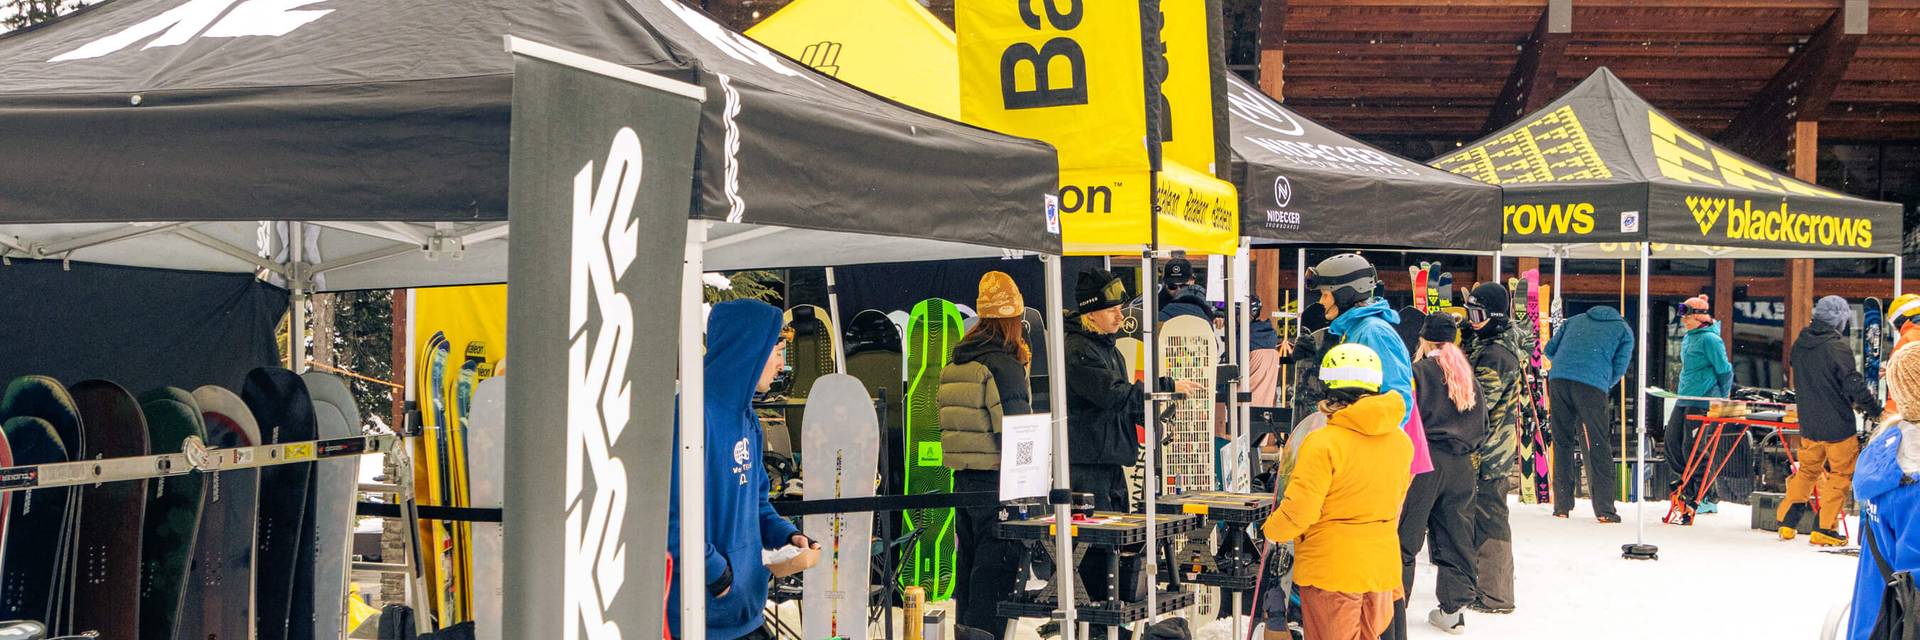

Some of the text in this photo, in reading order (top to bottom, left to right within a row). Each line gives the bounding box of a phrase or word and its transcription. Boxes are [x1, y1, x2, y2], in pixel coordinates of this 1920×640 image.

[1244, 136, 1402, 167] NIDECKER
[1267, 210, 1300, 223] NIDECKER
[1503, 203, 1595, 235] rows
[1727, 199, 1872, 248] blackcrows
